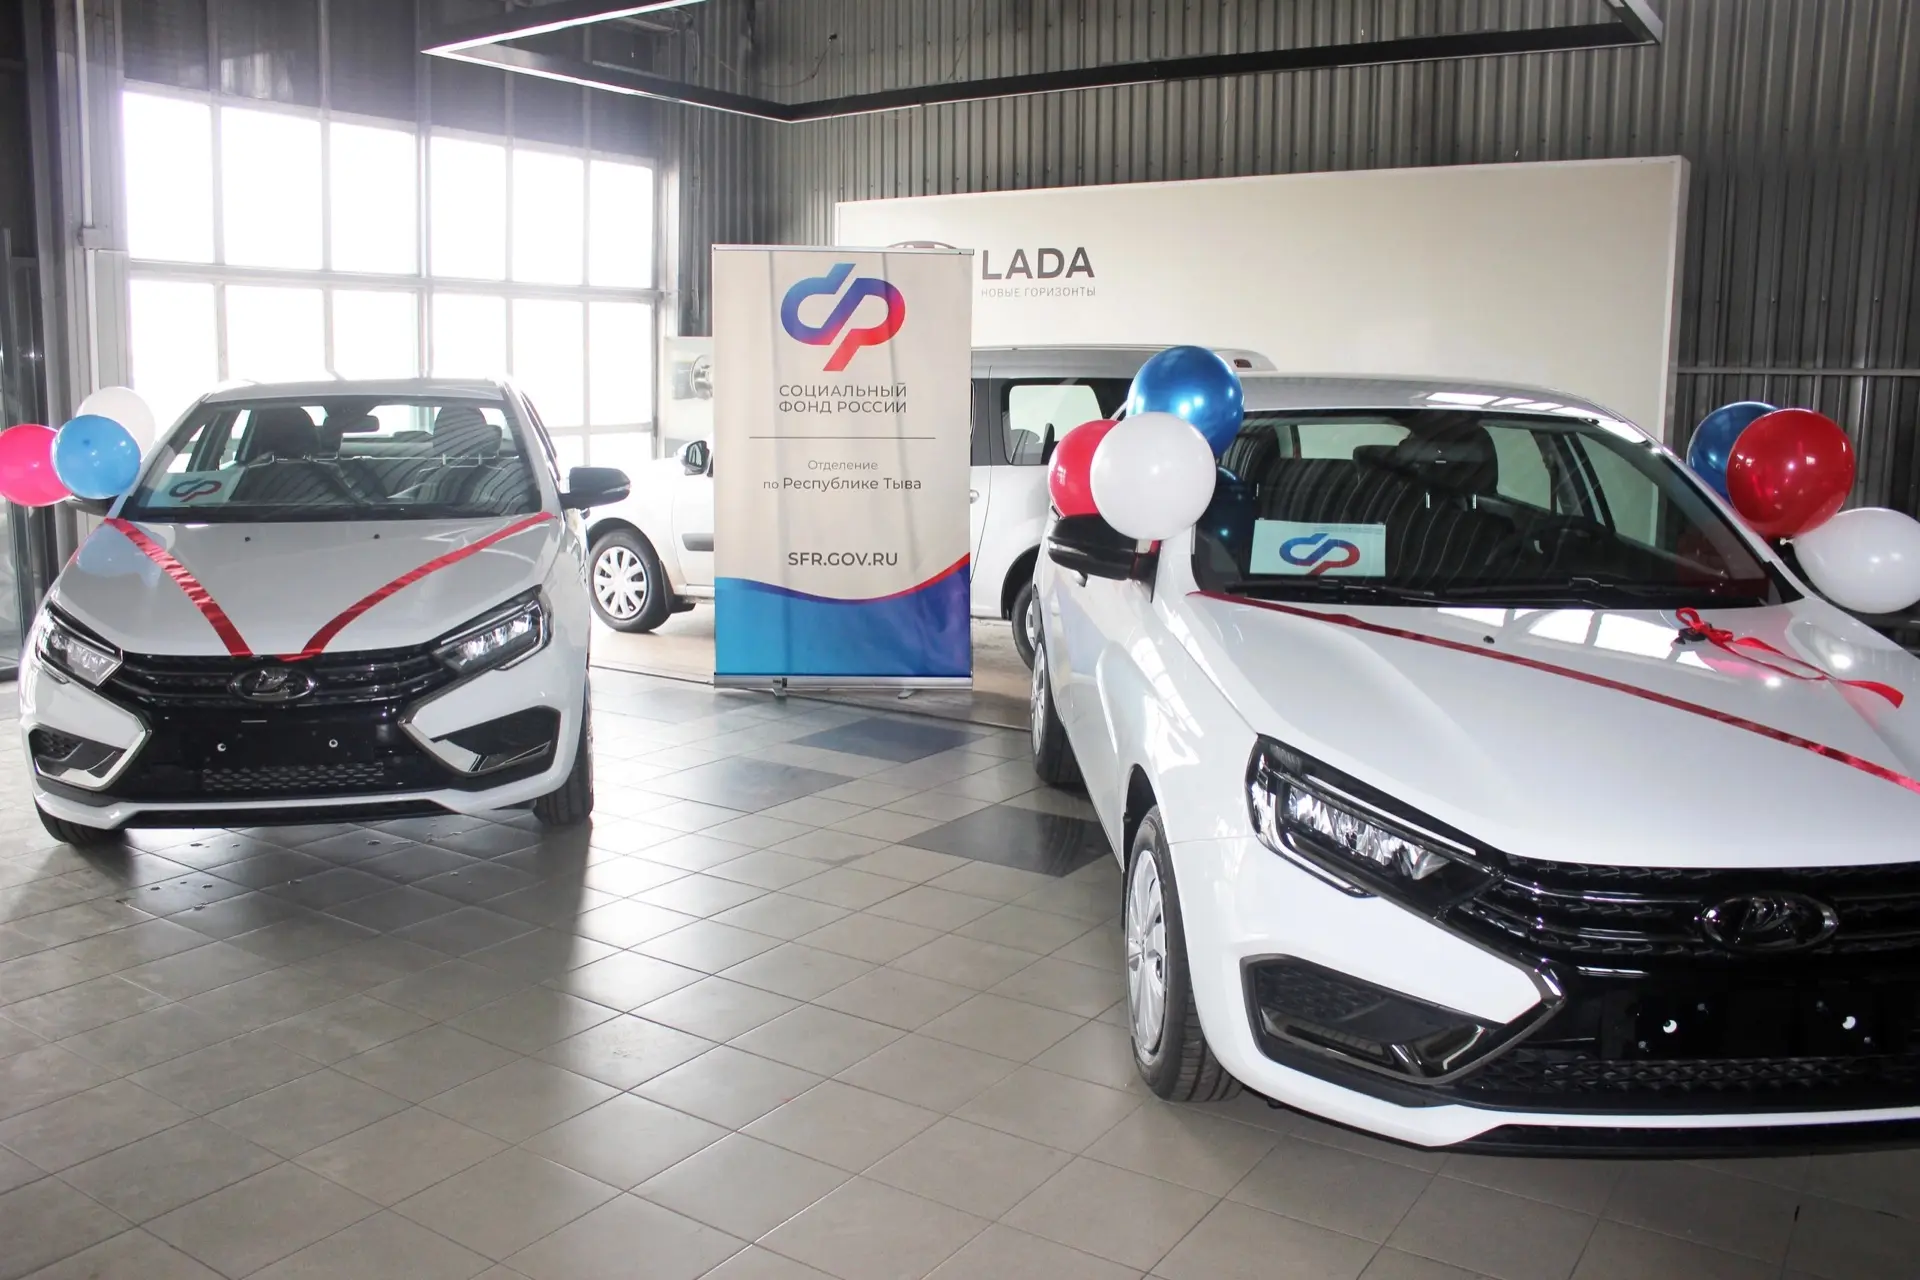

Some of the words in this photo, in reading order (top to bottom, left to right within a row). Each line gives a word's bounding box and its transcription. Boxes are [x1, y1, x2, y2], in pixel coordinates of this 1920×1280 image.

[981, 246, 1095, 280] LADA
[981, 287, 1021, 298] НОВЫЕ
[1023, 286, 1097, 298] ГОРИЗОНТЫ
[779, 382, 907, 398] СОЦИАЛЬНЫЙ
[779, 400, 832, 414] ФОНД
[837, 400, 907, 413] РОССИИ
[807, 459, 879, 471] Отделение
[763, 480, 779, 489] по
[783, 477, 879, 492] Республике
[883, 477, 922, 490] Тыва
[787, 552, 898, 566] SFR.GOV.RU
